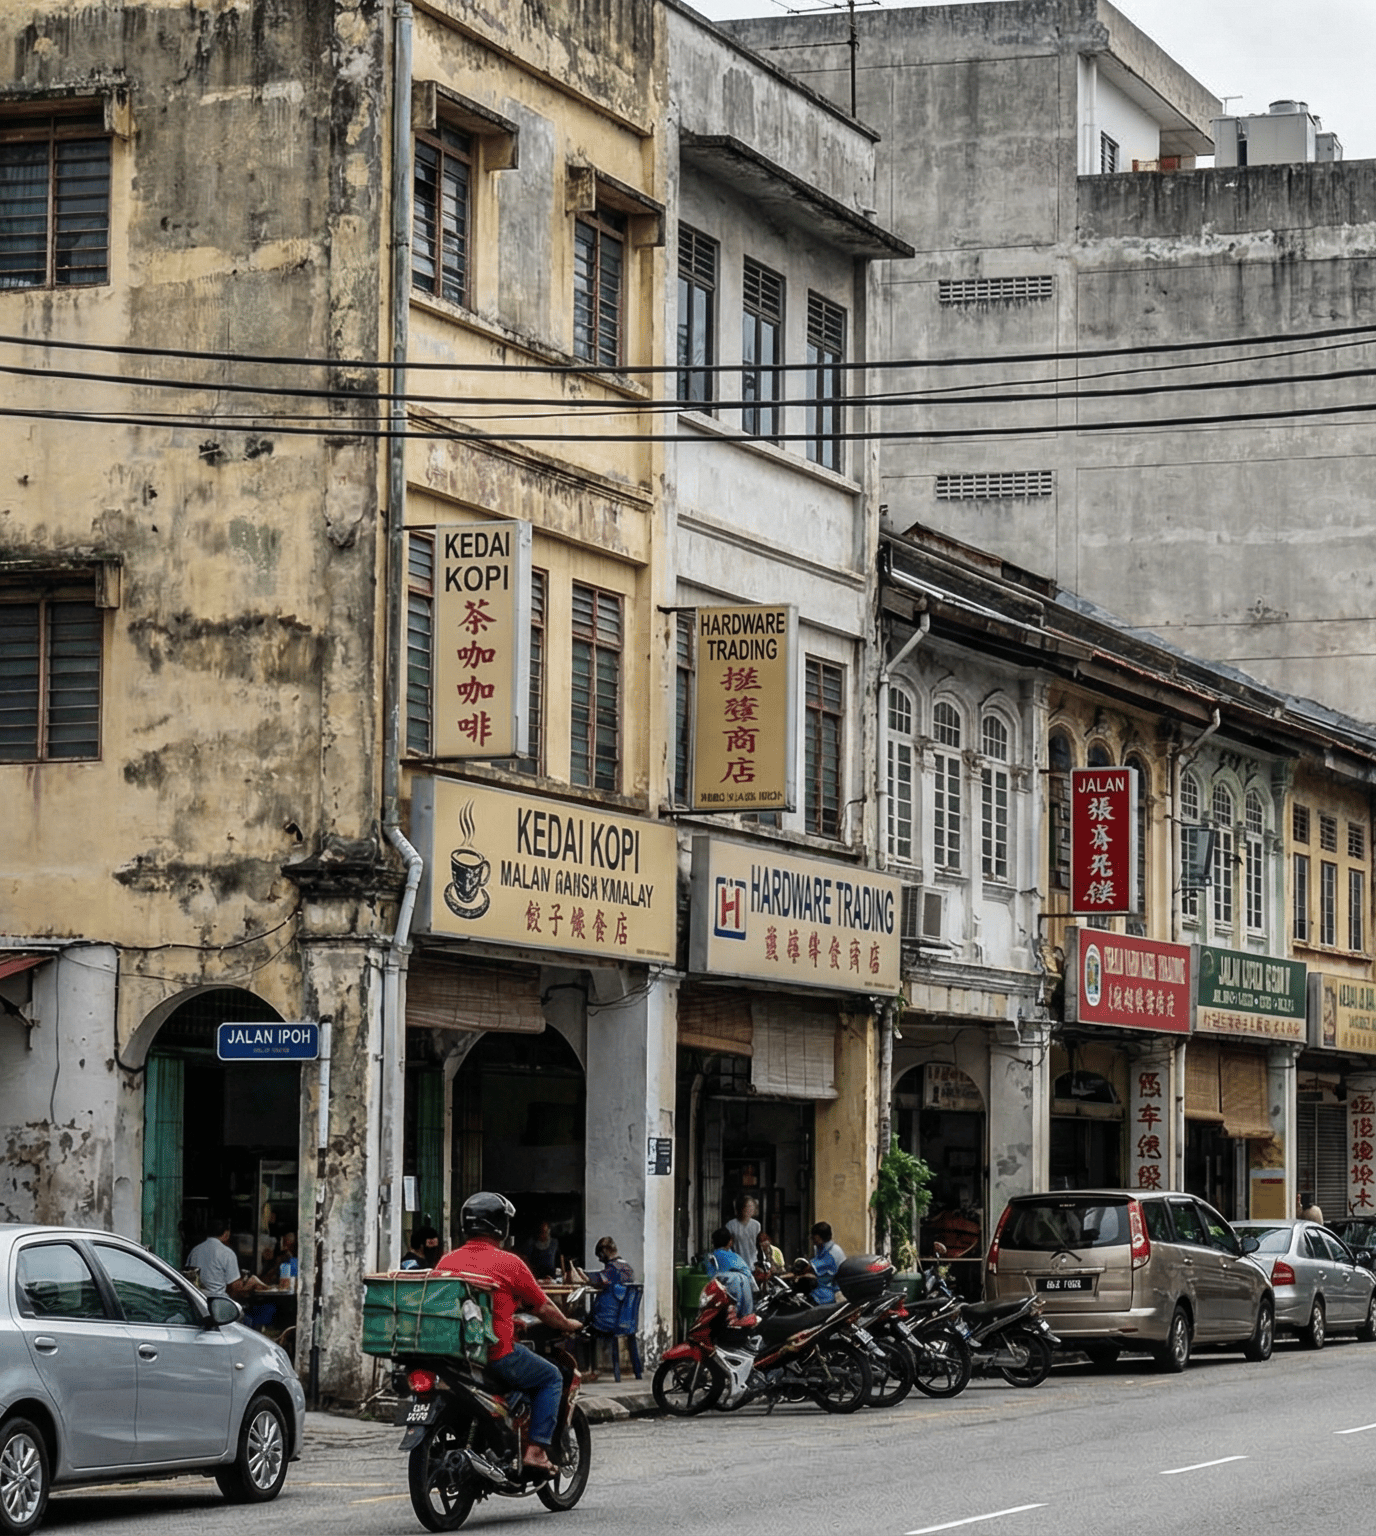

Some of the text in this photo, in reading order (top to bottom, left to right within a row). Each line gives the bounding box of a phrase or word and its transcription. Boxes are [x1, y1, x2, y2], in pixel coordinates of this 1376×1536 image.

[445, 531, 510, 559] KEDAI
[445, 564, 509, 592] KOPI
[701, 612, 785, 636] HARDWARE
[707, 638, 778, 661] TRADING
[457, 598, 497, 748] 茶咖咖啡
[1078, 776, 1125, 793] JALAN
[517, 807, 640, 874] KEDAI KOPI
[500, 860, 551, 892] MALAN
[751, 864, 894, 935] HARDWARE TRADING
[227, 1029, 311, 1044] JALAN IPOH
